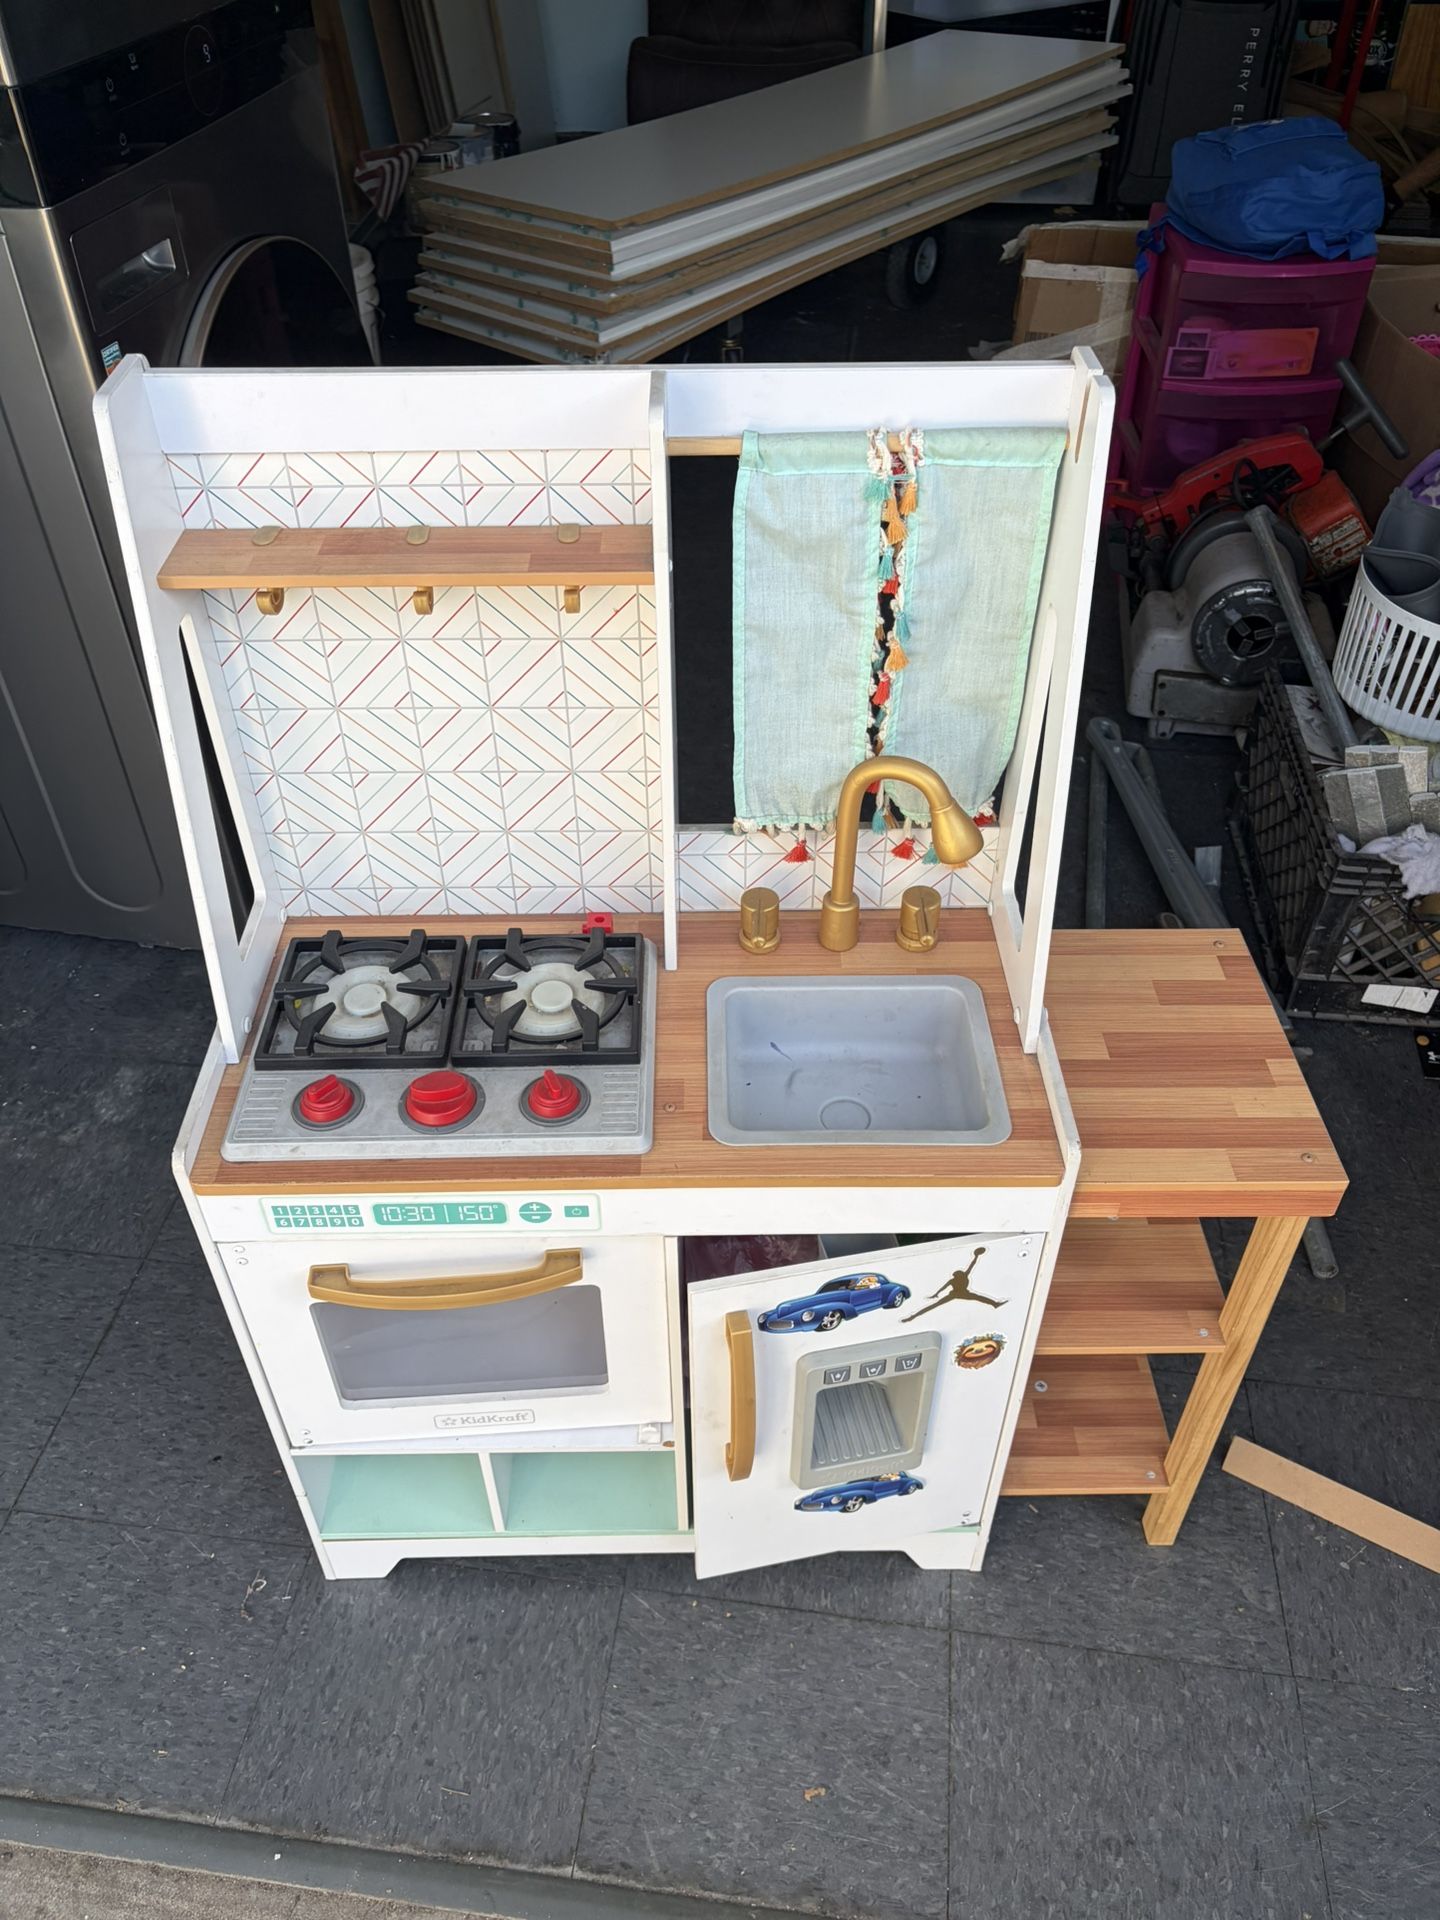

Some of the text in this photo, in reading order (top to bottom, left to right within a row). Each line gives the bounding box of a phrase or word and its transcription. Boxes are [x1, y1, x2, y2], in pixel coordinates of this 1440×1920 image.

[1231, 27, 1261, 125] PERRY EL
[381, 1205, 436, 1222] 10:30
[460, 1412, 527, 1425] KidKraft
